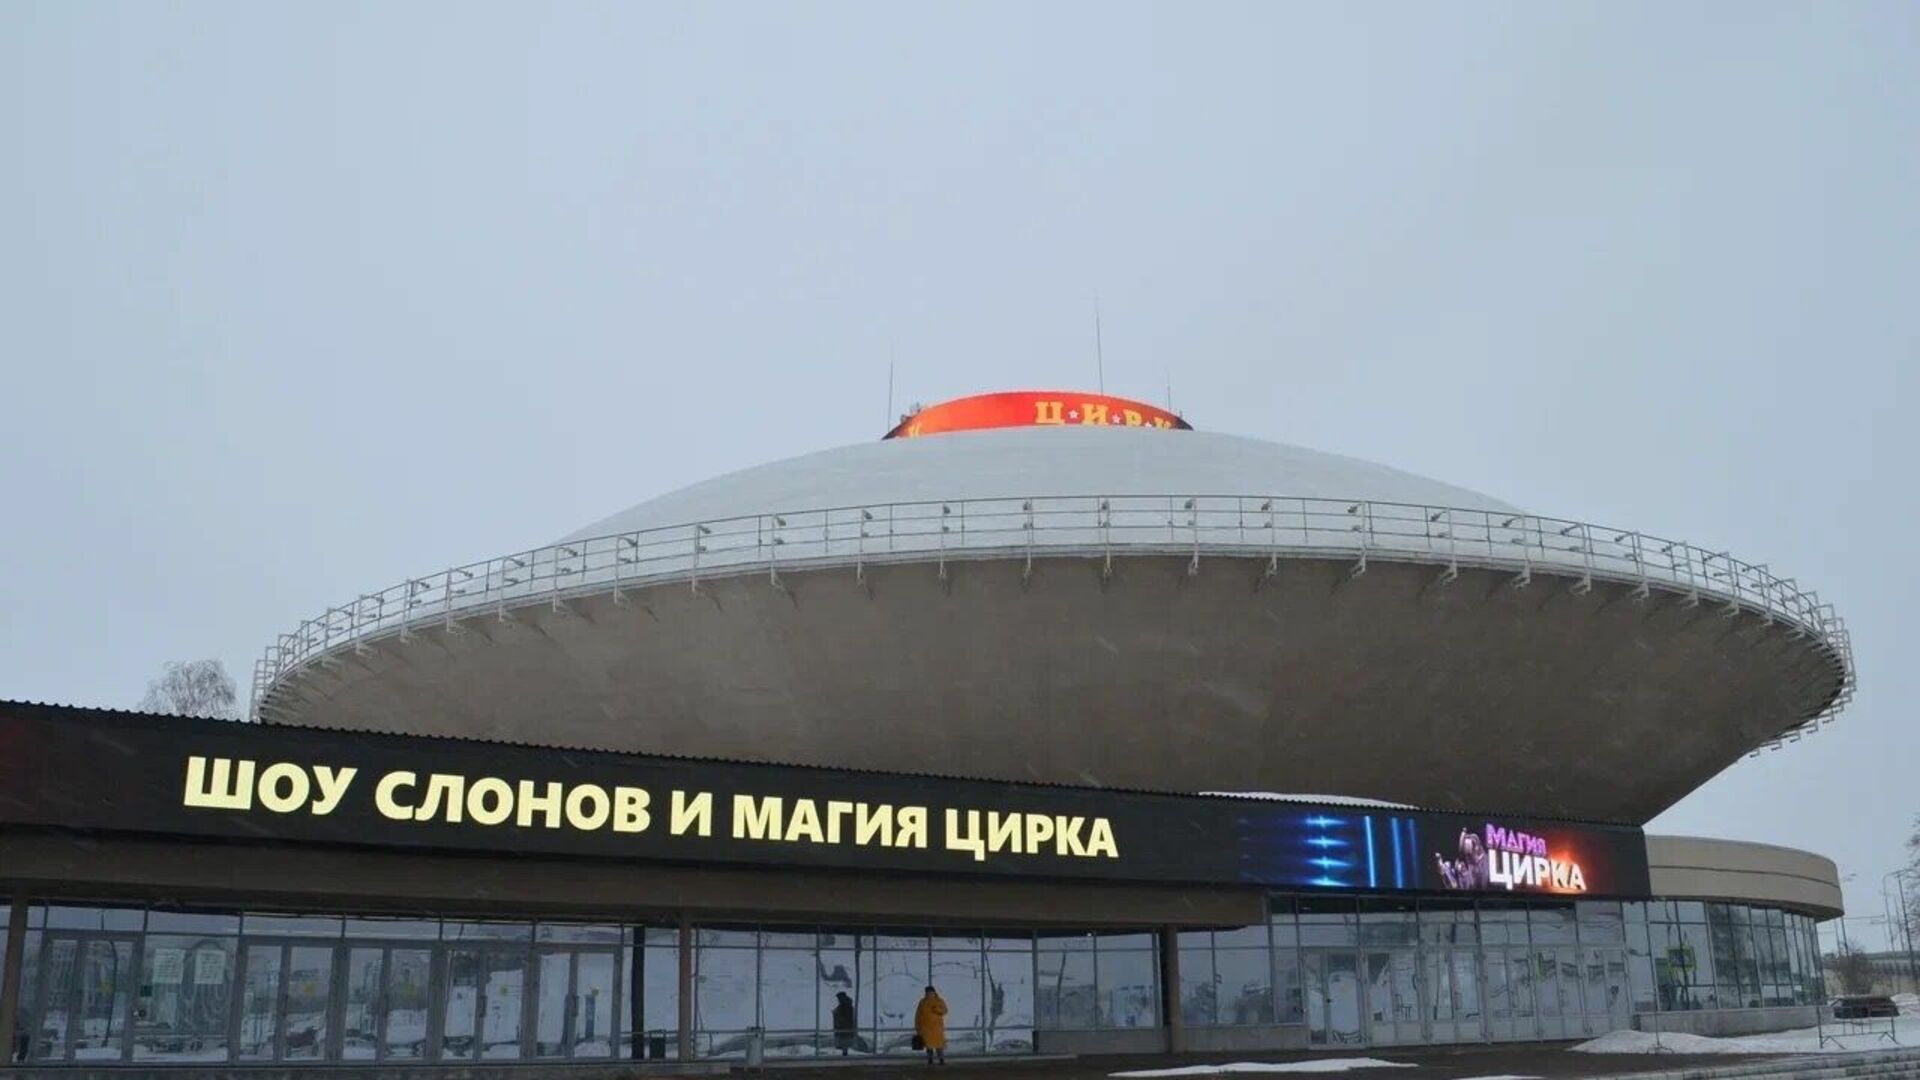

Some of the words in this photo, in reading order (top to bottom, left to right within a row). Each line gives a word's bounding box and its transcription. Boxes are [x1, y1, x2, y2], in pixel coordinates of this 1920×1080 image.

[183, 756, 358, 815] ШОУ
[375, 771, 651, 833] СЛОНОВ
[670, 790, 713, 837] И
[732, 794, 928, 849] МАГИЯ
[945, 808, 1119, 861] ЦИРКА
[1486, 823, 1546, 857] МАГИЯ
[1488, 849, 1587, 891] ЦИРКА
